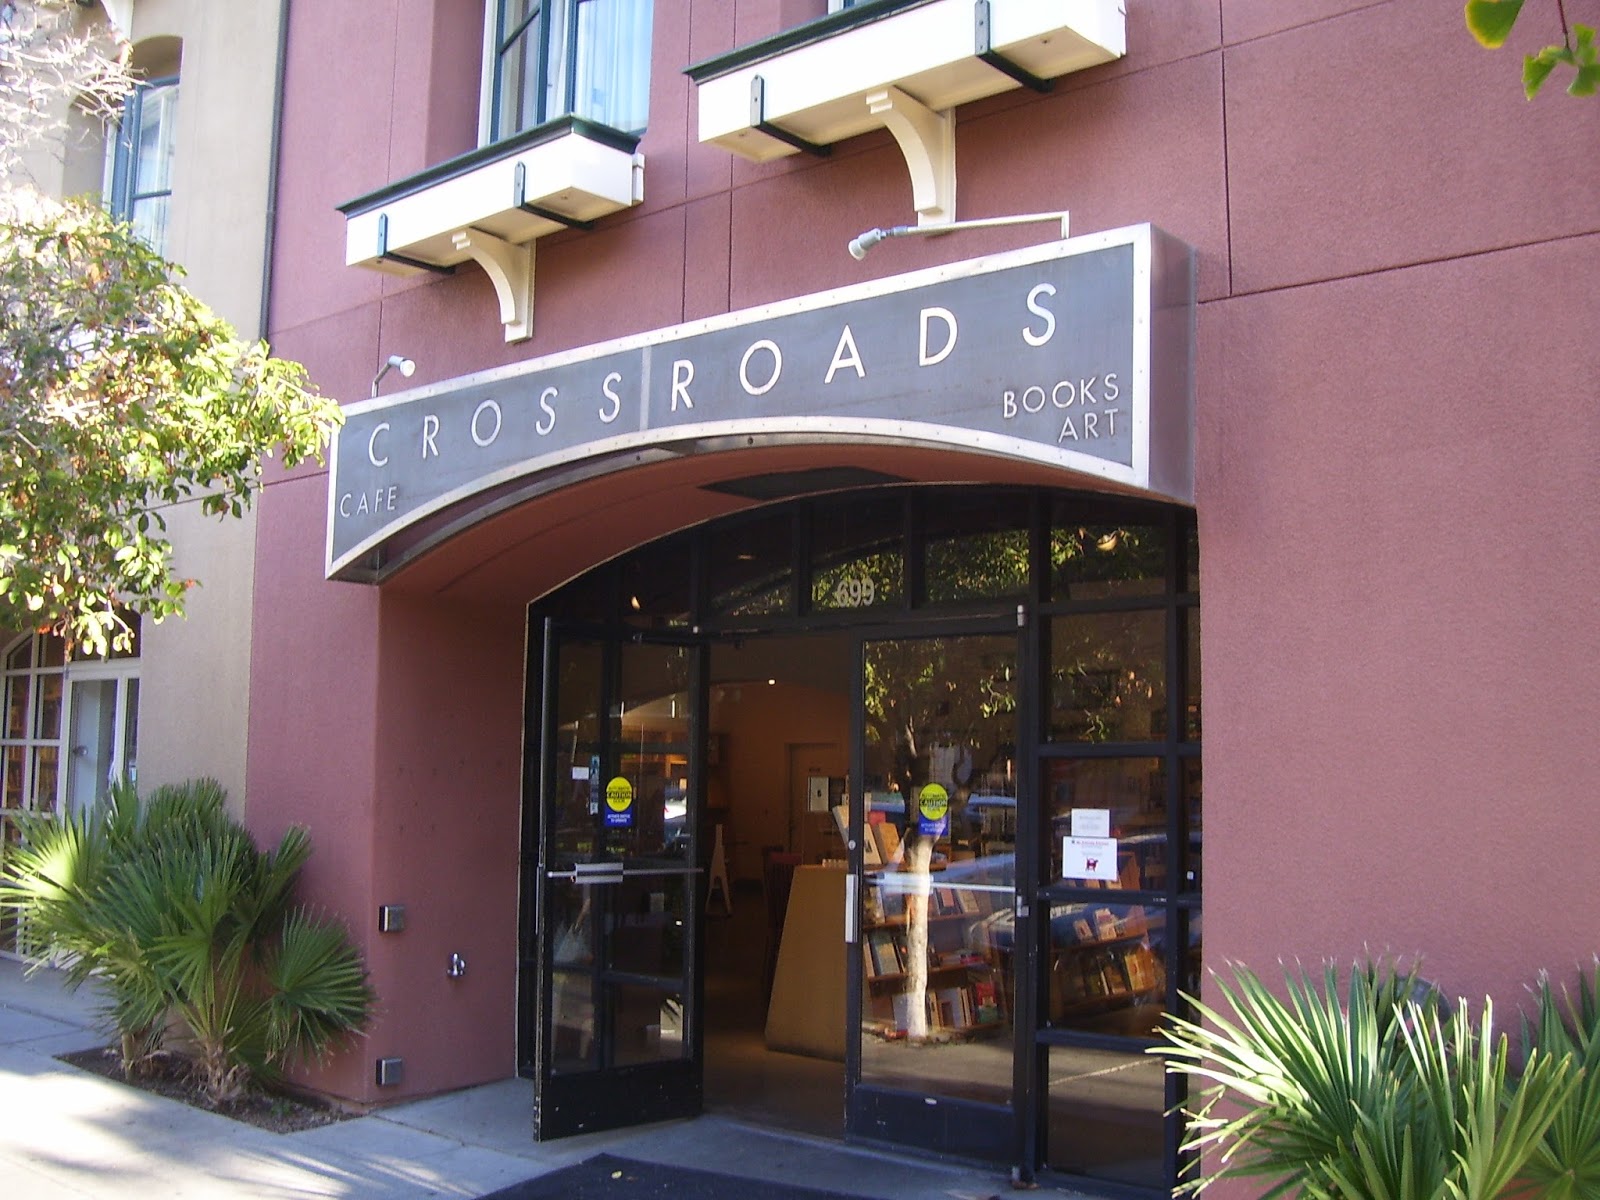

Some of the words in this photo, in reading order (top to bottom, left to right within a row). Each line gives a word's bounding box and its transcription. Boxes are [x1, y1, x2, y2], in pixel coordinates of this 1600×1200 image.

[1003, 373, 1119, 418] BOOKS
[1058, 408, 1118, 443] ART
[339, 486, 397, 518] CAFE
[837, 577, 874, 607] 699
